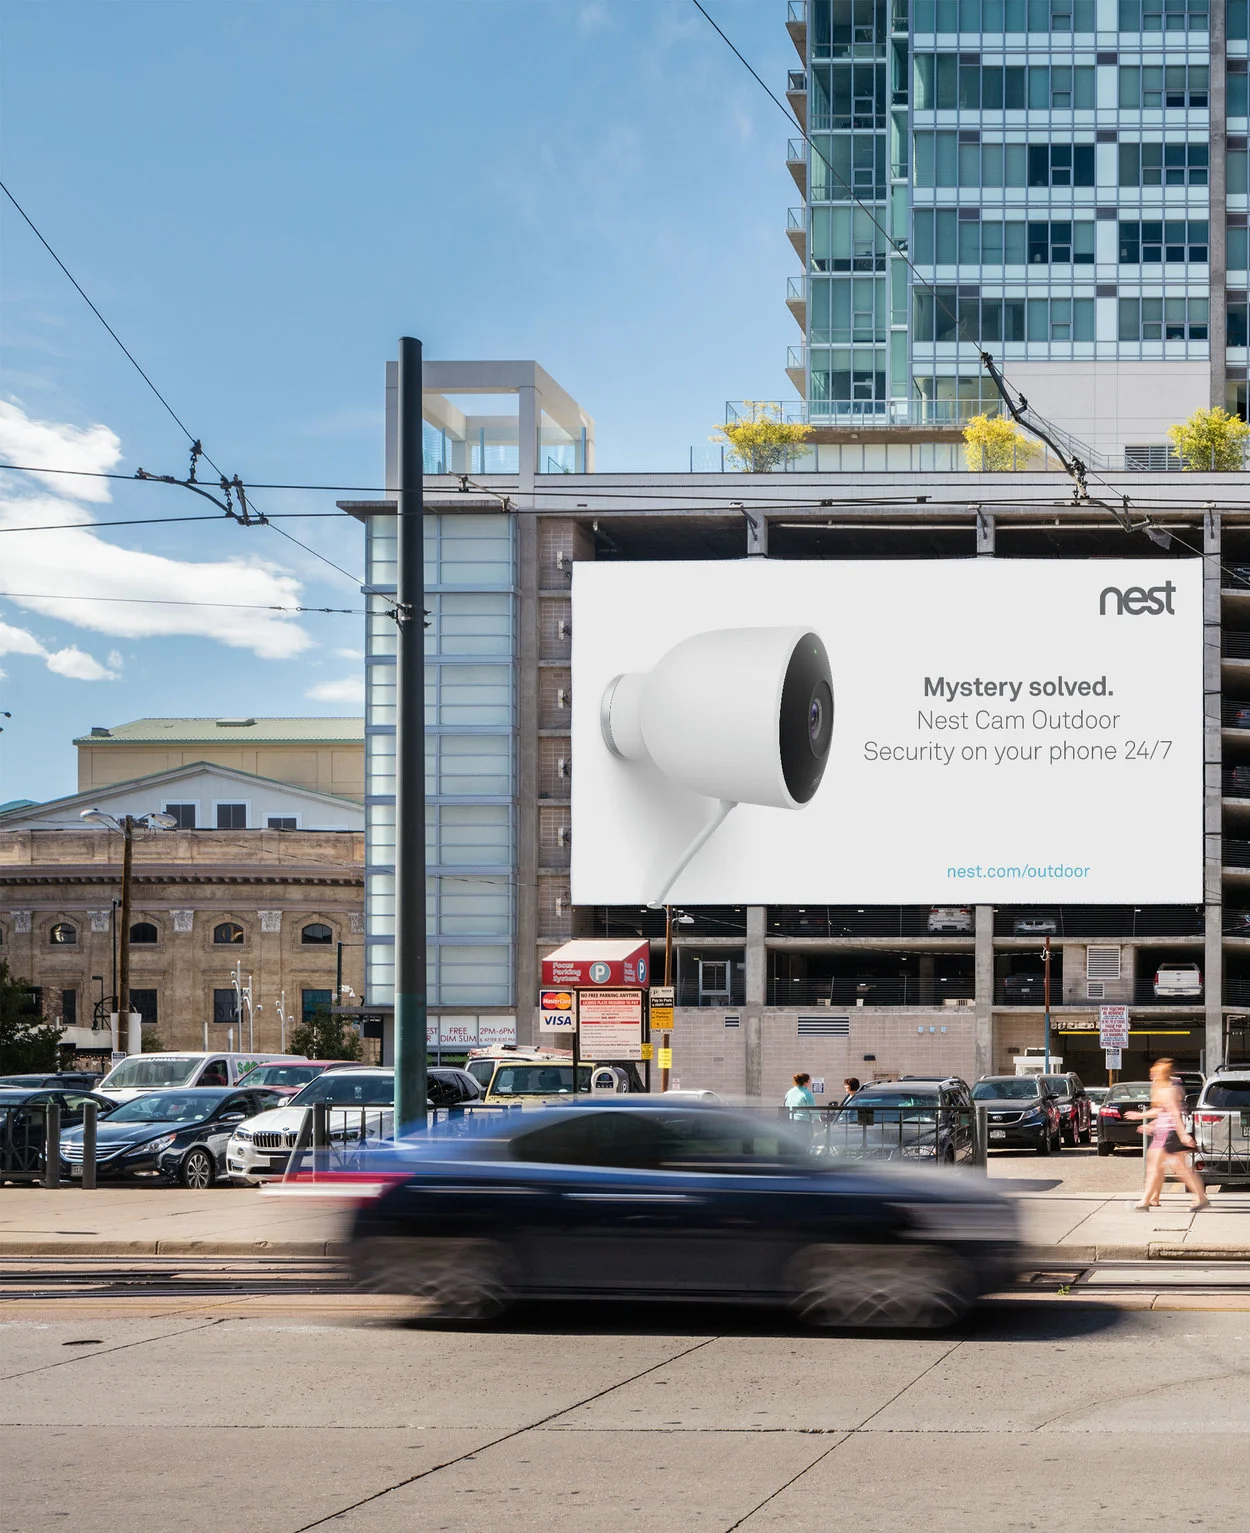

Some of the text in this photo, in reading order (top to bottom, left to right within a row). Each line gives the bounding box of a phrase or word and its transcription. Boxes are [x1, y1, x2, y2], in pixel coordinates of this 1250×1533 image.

[1100, 580, 1176, 615] nest
[924, 676, 1114, 702] Mystery solved.
[918, 709, 1121, 730] Nest Cam Outdoor
[863, 740, 1173, 765] Security on your phone 24/7
[948, 864, 1091, 879] nest.com/outdoor
[543, 1016, 572, 1026] VISA
[440, 1034, 457, 1042] DIM
[459, 1034, 477, 1042] SUM
[449, 1027, 468, 1035] FREE
[480, 1027, 515, 1035] 2PM-6PM
